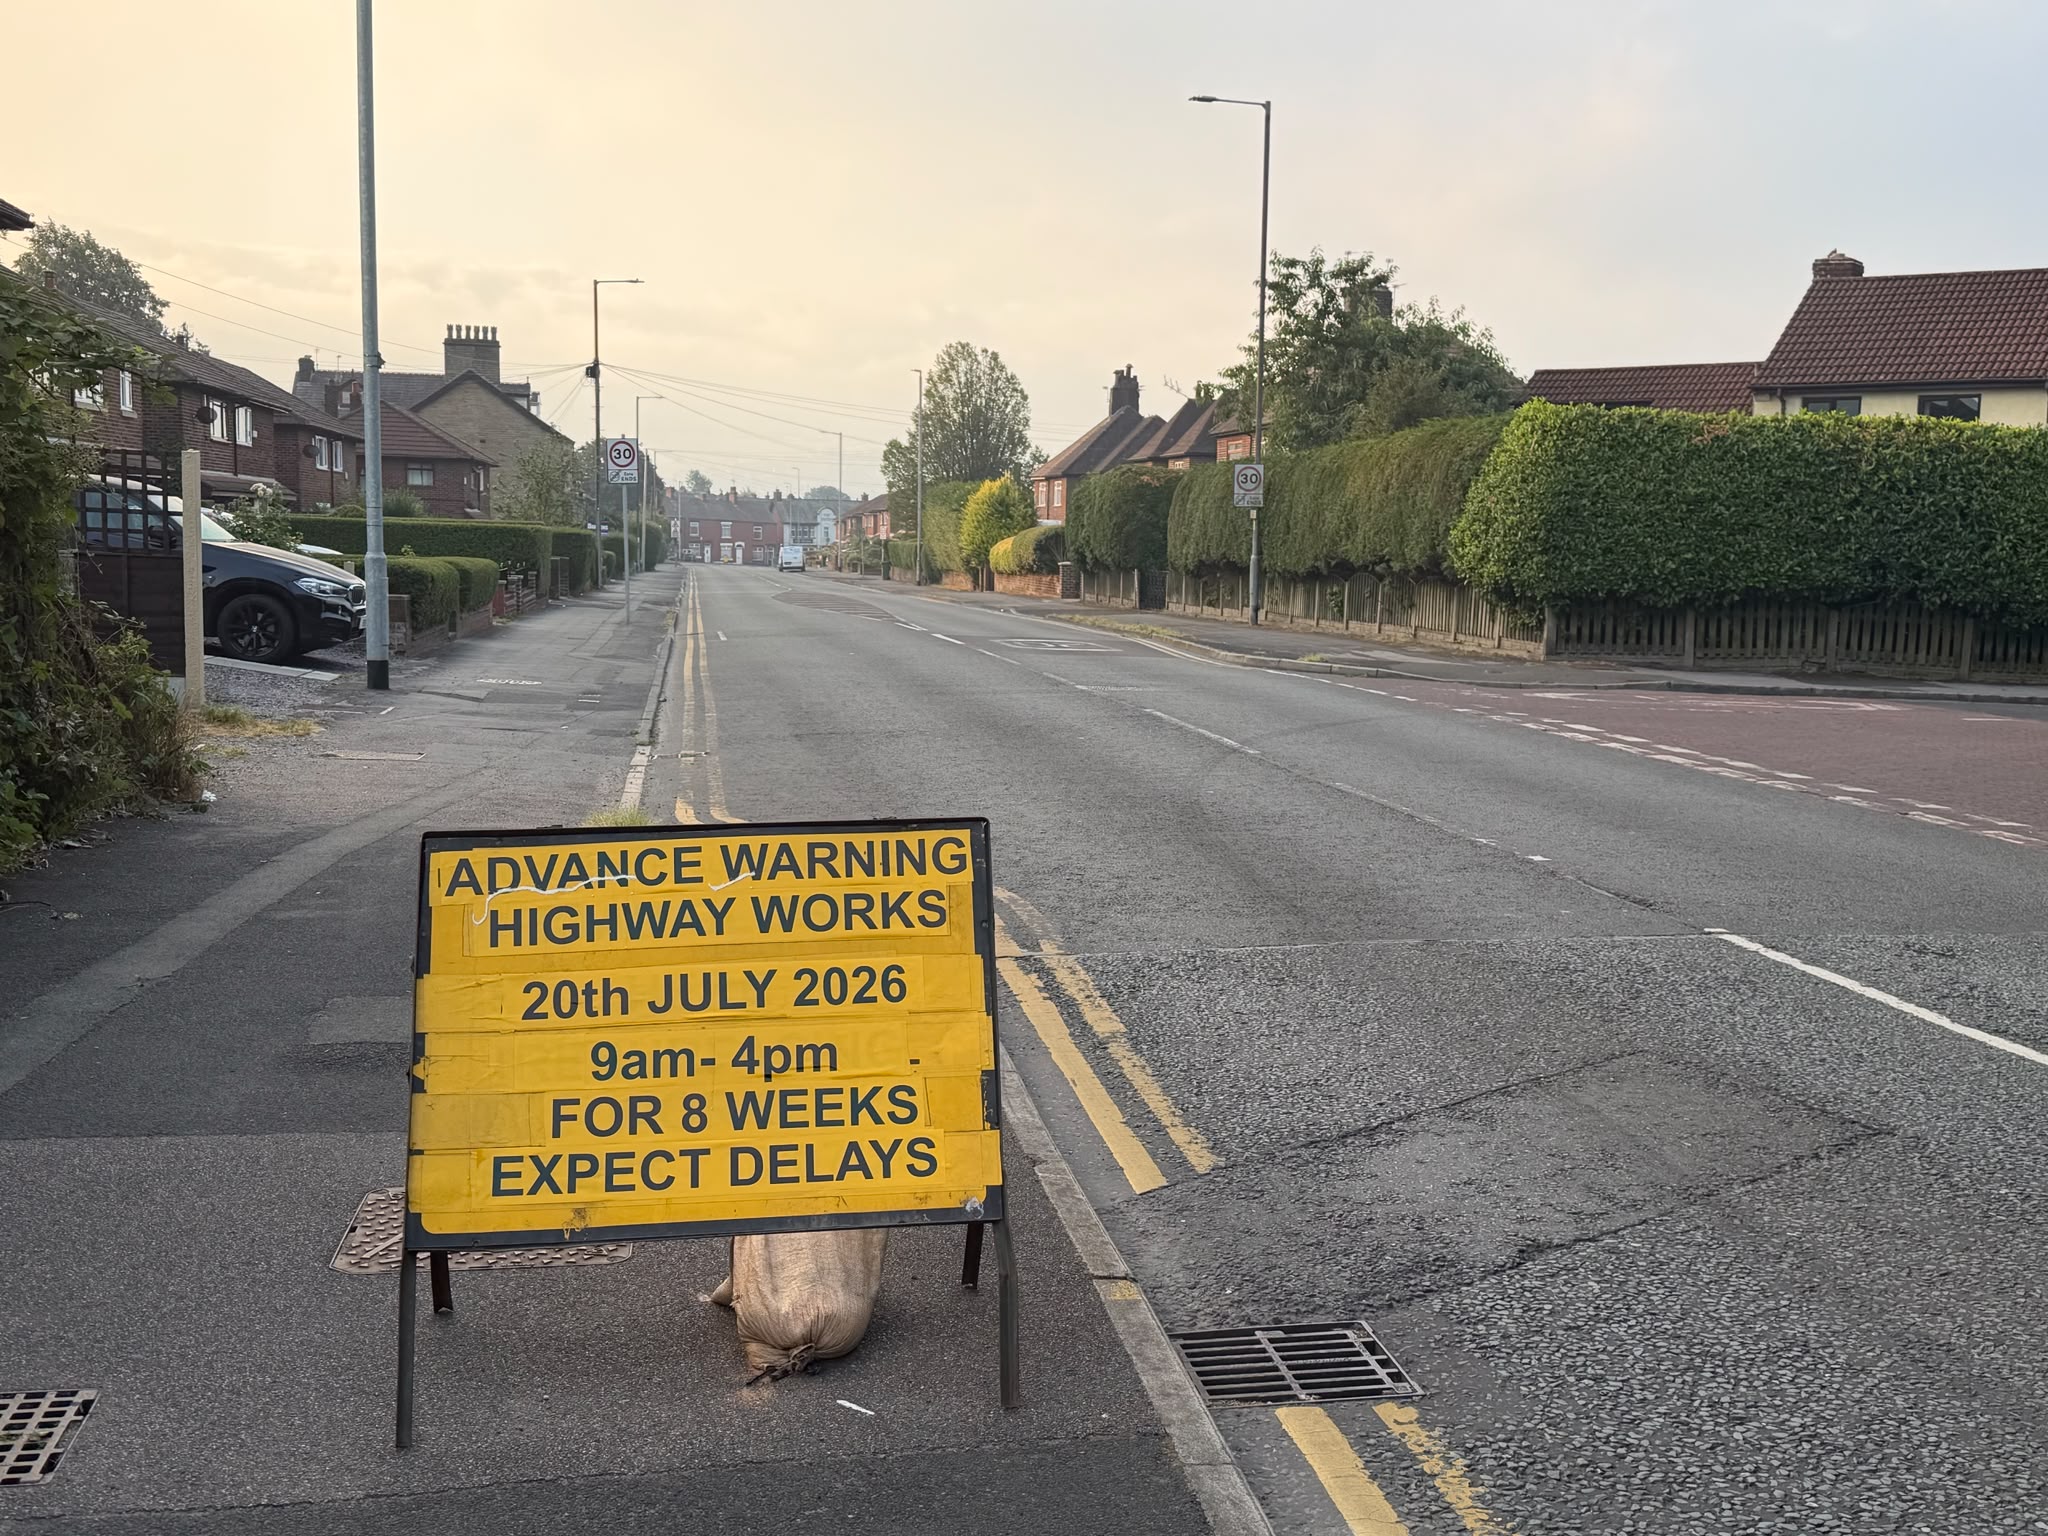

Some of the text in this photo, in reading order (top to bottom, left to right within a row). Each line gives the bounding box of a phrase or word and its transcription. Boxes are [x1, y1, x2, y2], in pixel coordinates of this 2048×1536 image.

[613, 448, 632, 460] 30
[1240, 473, 1259, 484] 30
[444, 836, 968, 897] ADVANCE WARNING
[489, 889, 947, 948] HIGHWAY WORKS
[521, 964, 907, 1021] 20th JULY 2026
[731, 1035, 838, 1082] 4pm
[551, 1084, 918, 1139] FOR 8 WEEKS
[491, 1137, 938, 1198] EXPECT DELAYS
